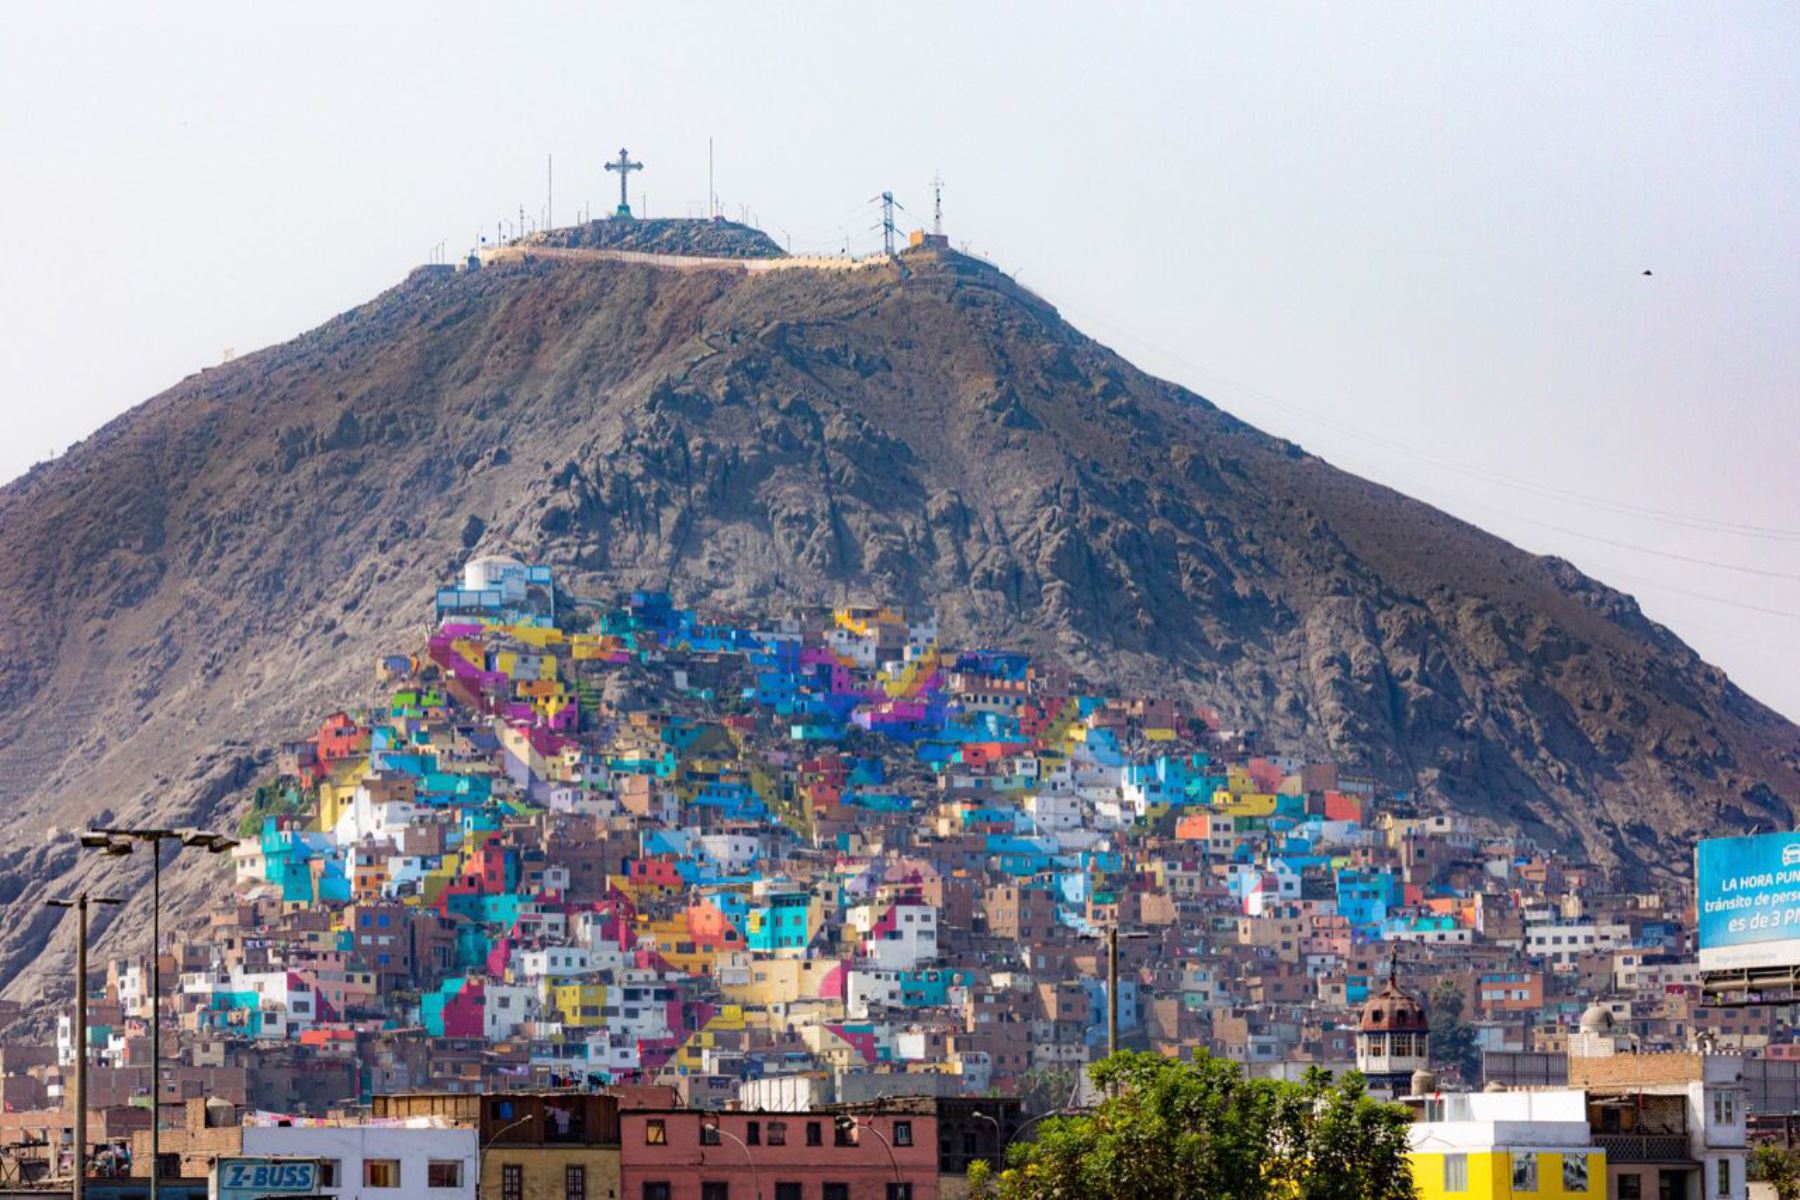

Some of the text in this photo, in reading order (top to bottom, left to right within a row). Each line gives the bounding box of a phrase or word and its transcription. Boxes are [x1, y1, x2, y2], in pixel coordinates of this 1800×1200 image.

[1722, 878, 1737, 892] LA
[1740, 873, 1773, 889] HORA
[1705, 894, 1752, 913] tránsito
[1755, 891, 1770, 906] de
[1728, 918, 1745, 932] es
[1750, 912, 1768, 929] de
[1771, 910, 1780, 927] 3
[229, 1166, 310, 1186] Z-BUSS
